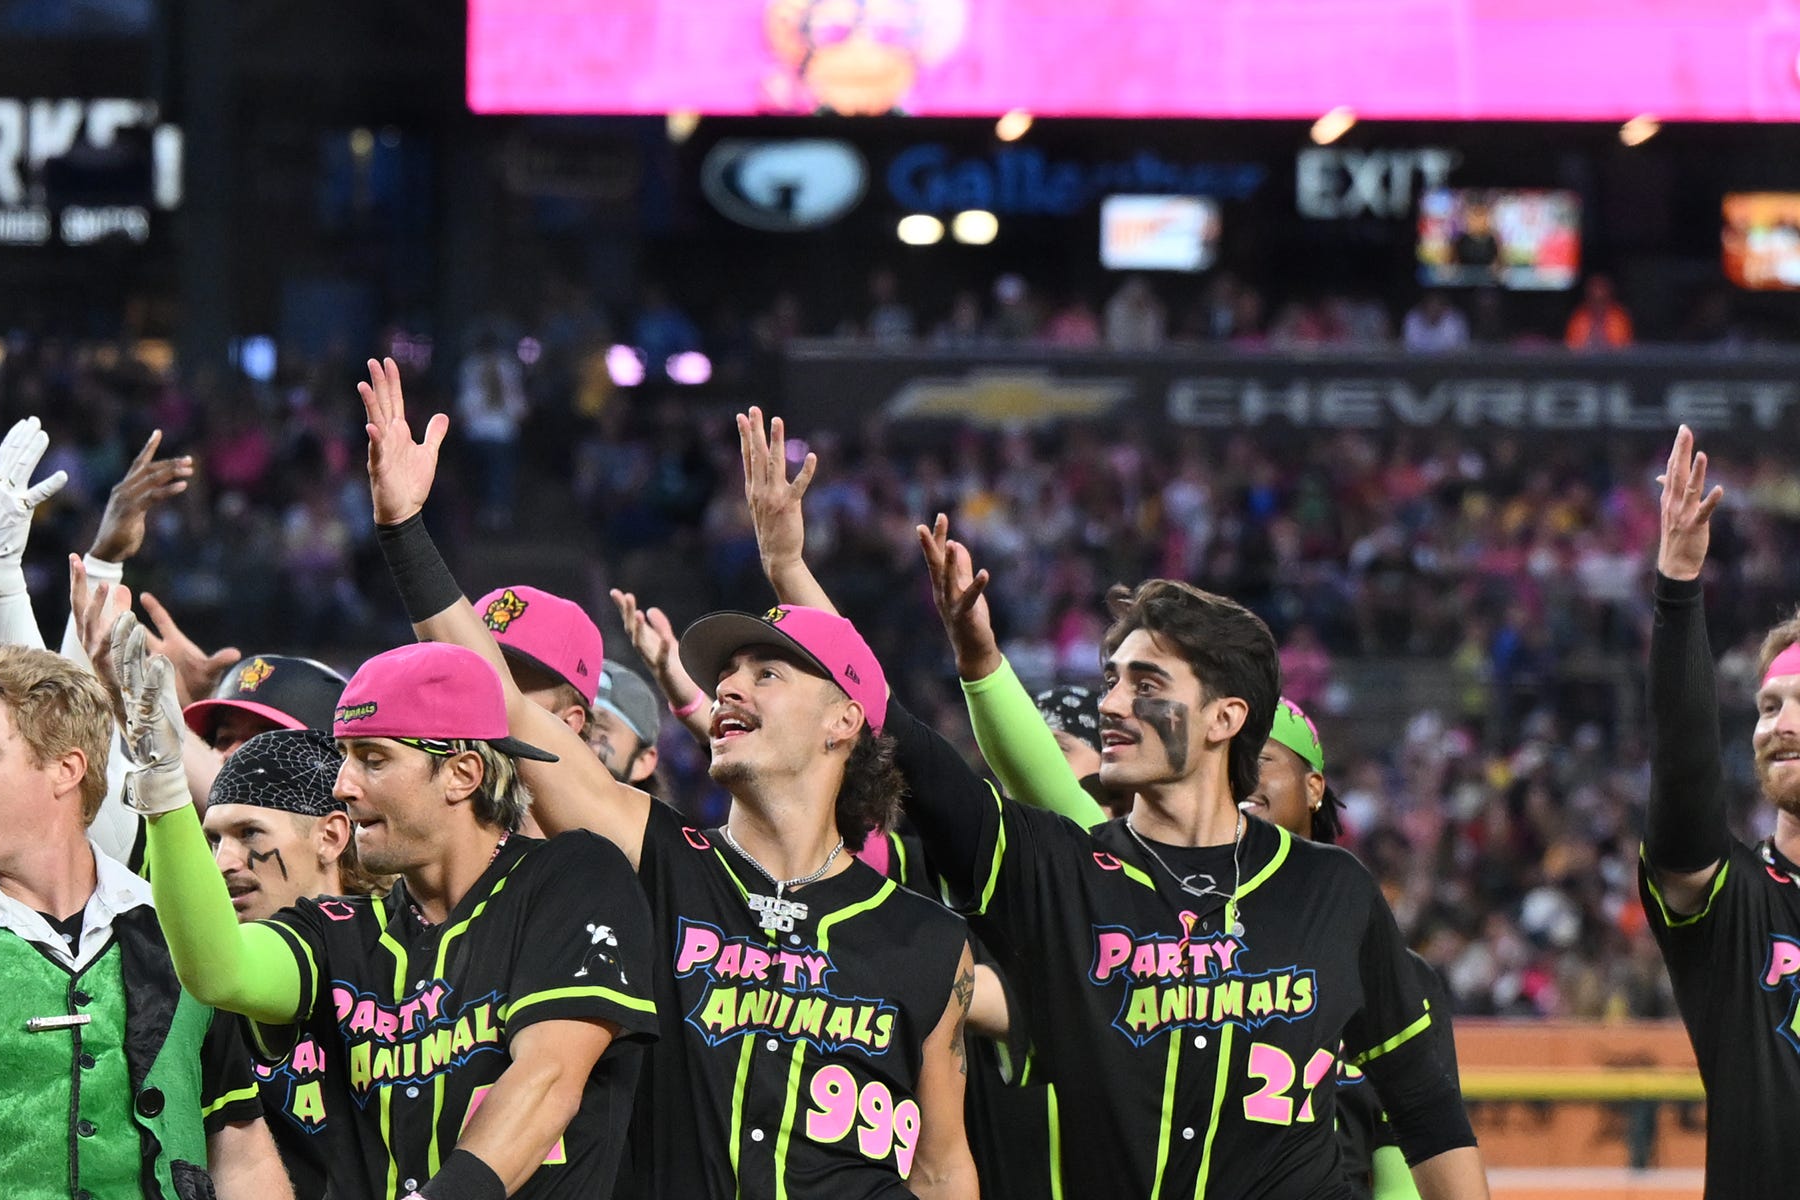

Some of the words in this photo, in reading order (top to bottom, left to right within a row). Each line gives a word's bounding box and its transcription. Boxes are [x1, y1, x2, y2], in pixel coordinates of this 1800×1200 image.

[1166, 378, 1798, 430] CHEVROLET
[676, 926, 828, 986] PARTY
[1096, 932, 1238, 980] PARTY
[700, 986, 893, 1049] ANIMALS
[1125, 973, 1314, 1032] ANIMALS
[806, 1064, 921, 1180] 999
